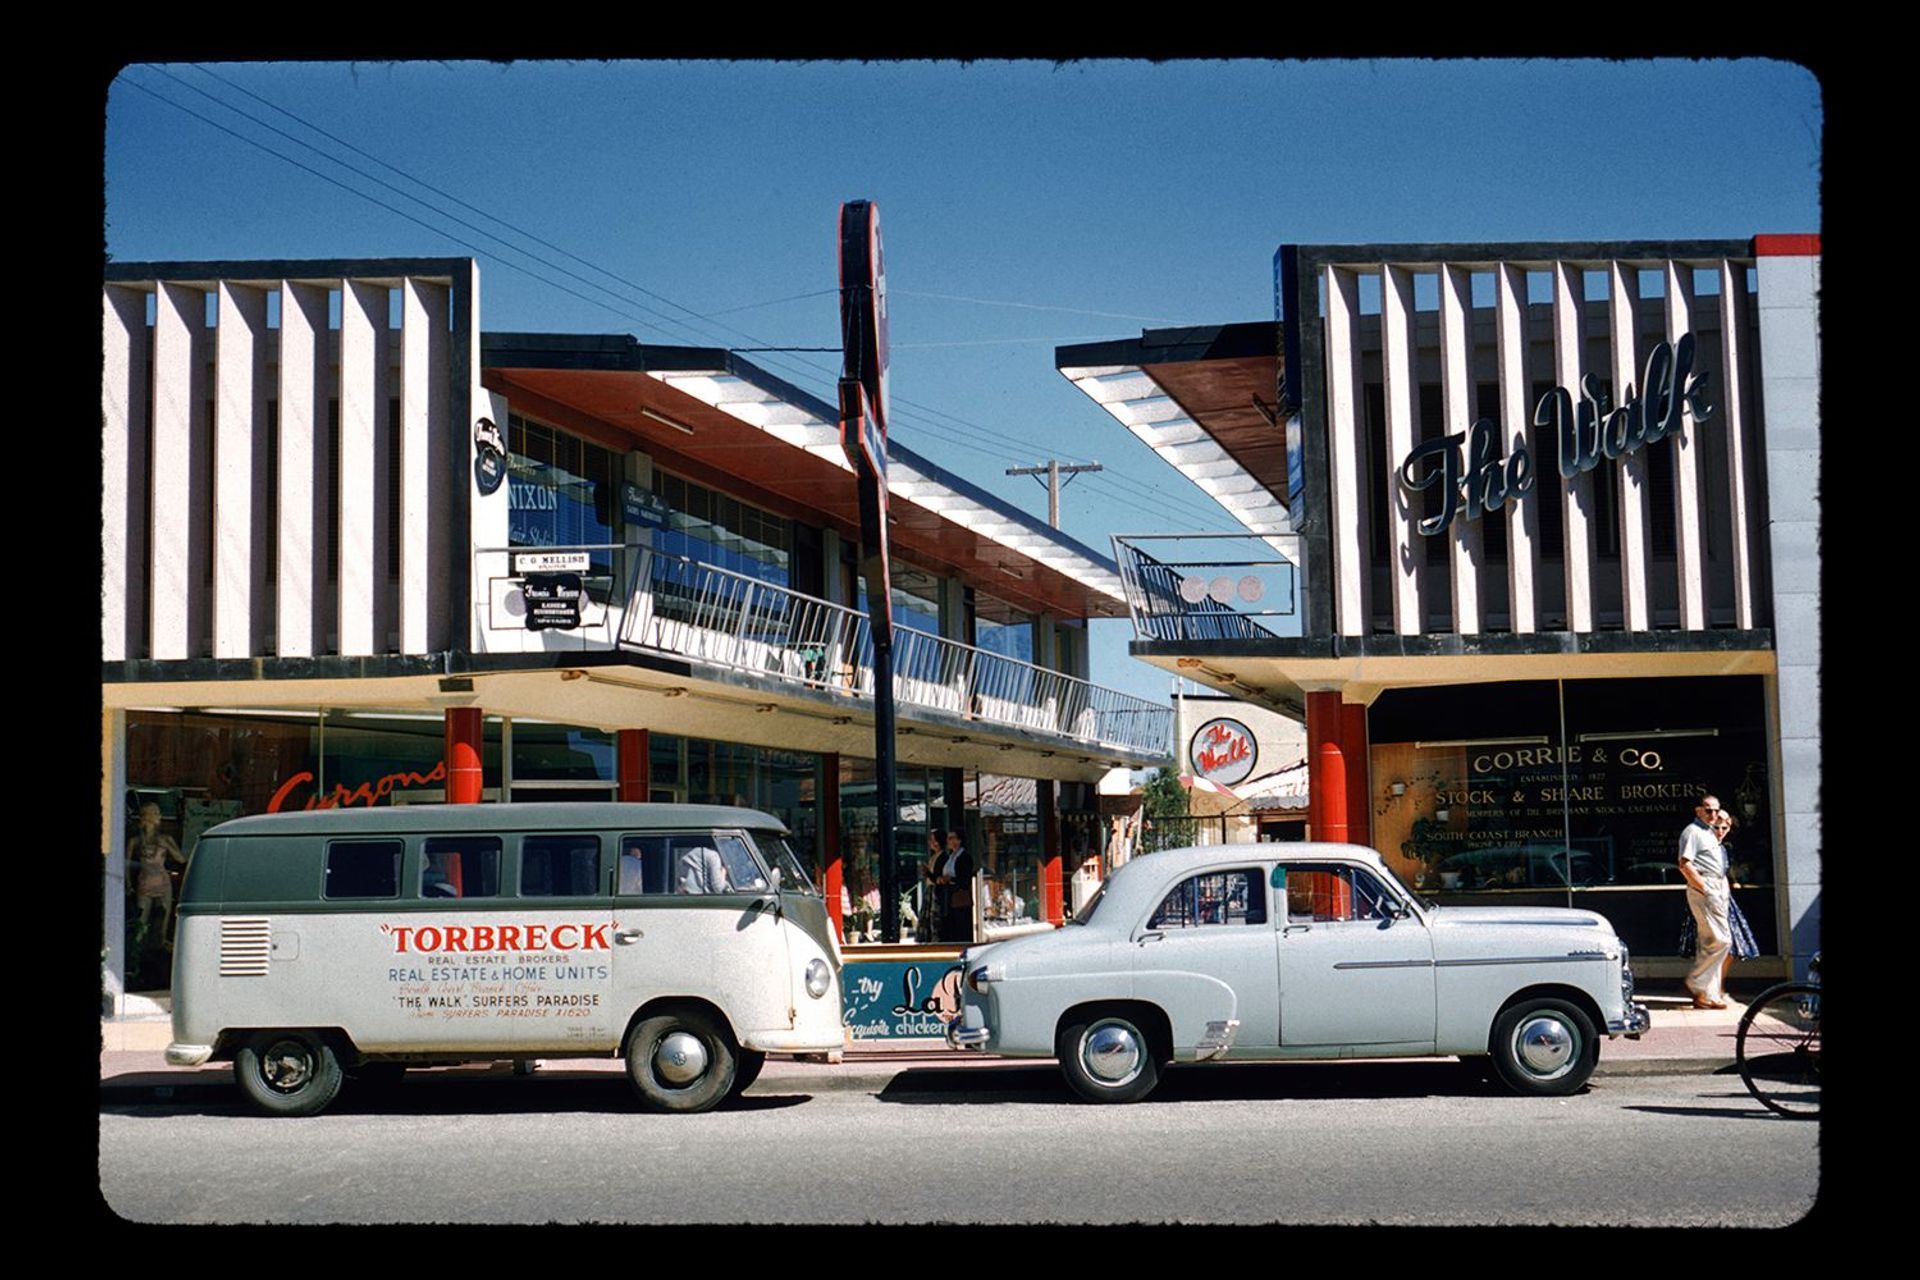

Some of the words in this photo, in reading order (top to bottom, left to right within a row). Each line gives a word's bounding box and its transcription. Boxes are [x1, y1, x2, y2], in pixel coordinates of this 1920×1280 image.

[1401, 417, 1535, 536] The
[1534, 332, 1714, 479] Walk
[508, 484, 558, 510] NIXON
[542, 556, 585, 564] MELLISH
[1206, 724, 1232, 745] The
[1197, 735, 1251, 771] Walk
[1473, 746, 1582, 773] CORRIE
[1592, 746, 1608, 762] &
[1620, 748, 1663, 771] CO.
[1435, 790, 1496, 805] STOCK
[1512, 789, 1525, 803] &
[1541, 786, 1605, 801] SHARE
[1621, 783, 1707, 800] BROKERS
[1469, 831, 1509, 840] COAST
[1515, 828, 1563, 839] BRANCH
[380, 919, 620, 953] "TORBRECK"
[428, 956, 455, 965] REAL
[466, 955, 506, 964] ESTATE
[519, 954, 570, 964] BROKERS
[389, 968, 425, 982] REAL
[432, 967, 487, 982] ESTATE
[491, 970, 498, 981] &
[503, 966, 546, 981] HOME
[555, 966, 608, 980] UNITS
[858, 976, 884, 1002] try
[473, 995, 529, 1007] SURFERS
[537, 994, 600, 1006] PARADISE
[443, 1009, 489, 1019] SURFERS
[496, 1008, 548, 1018] PARADISE
[895, 1015, 946, 1035] chicken
